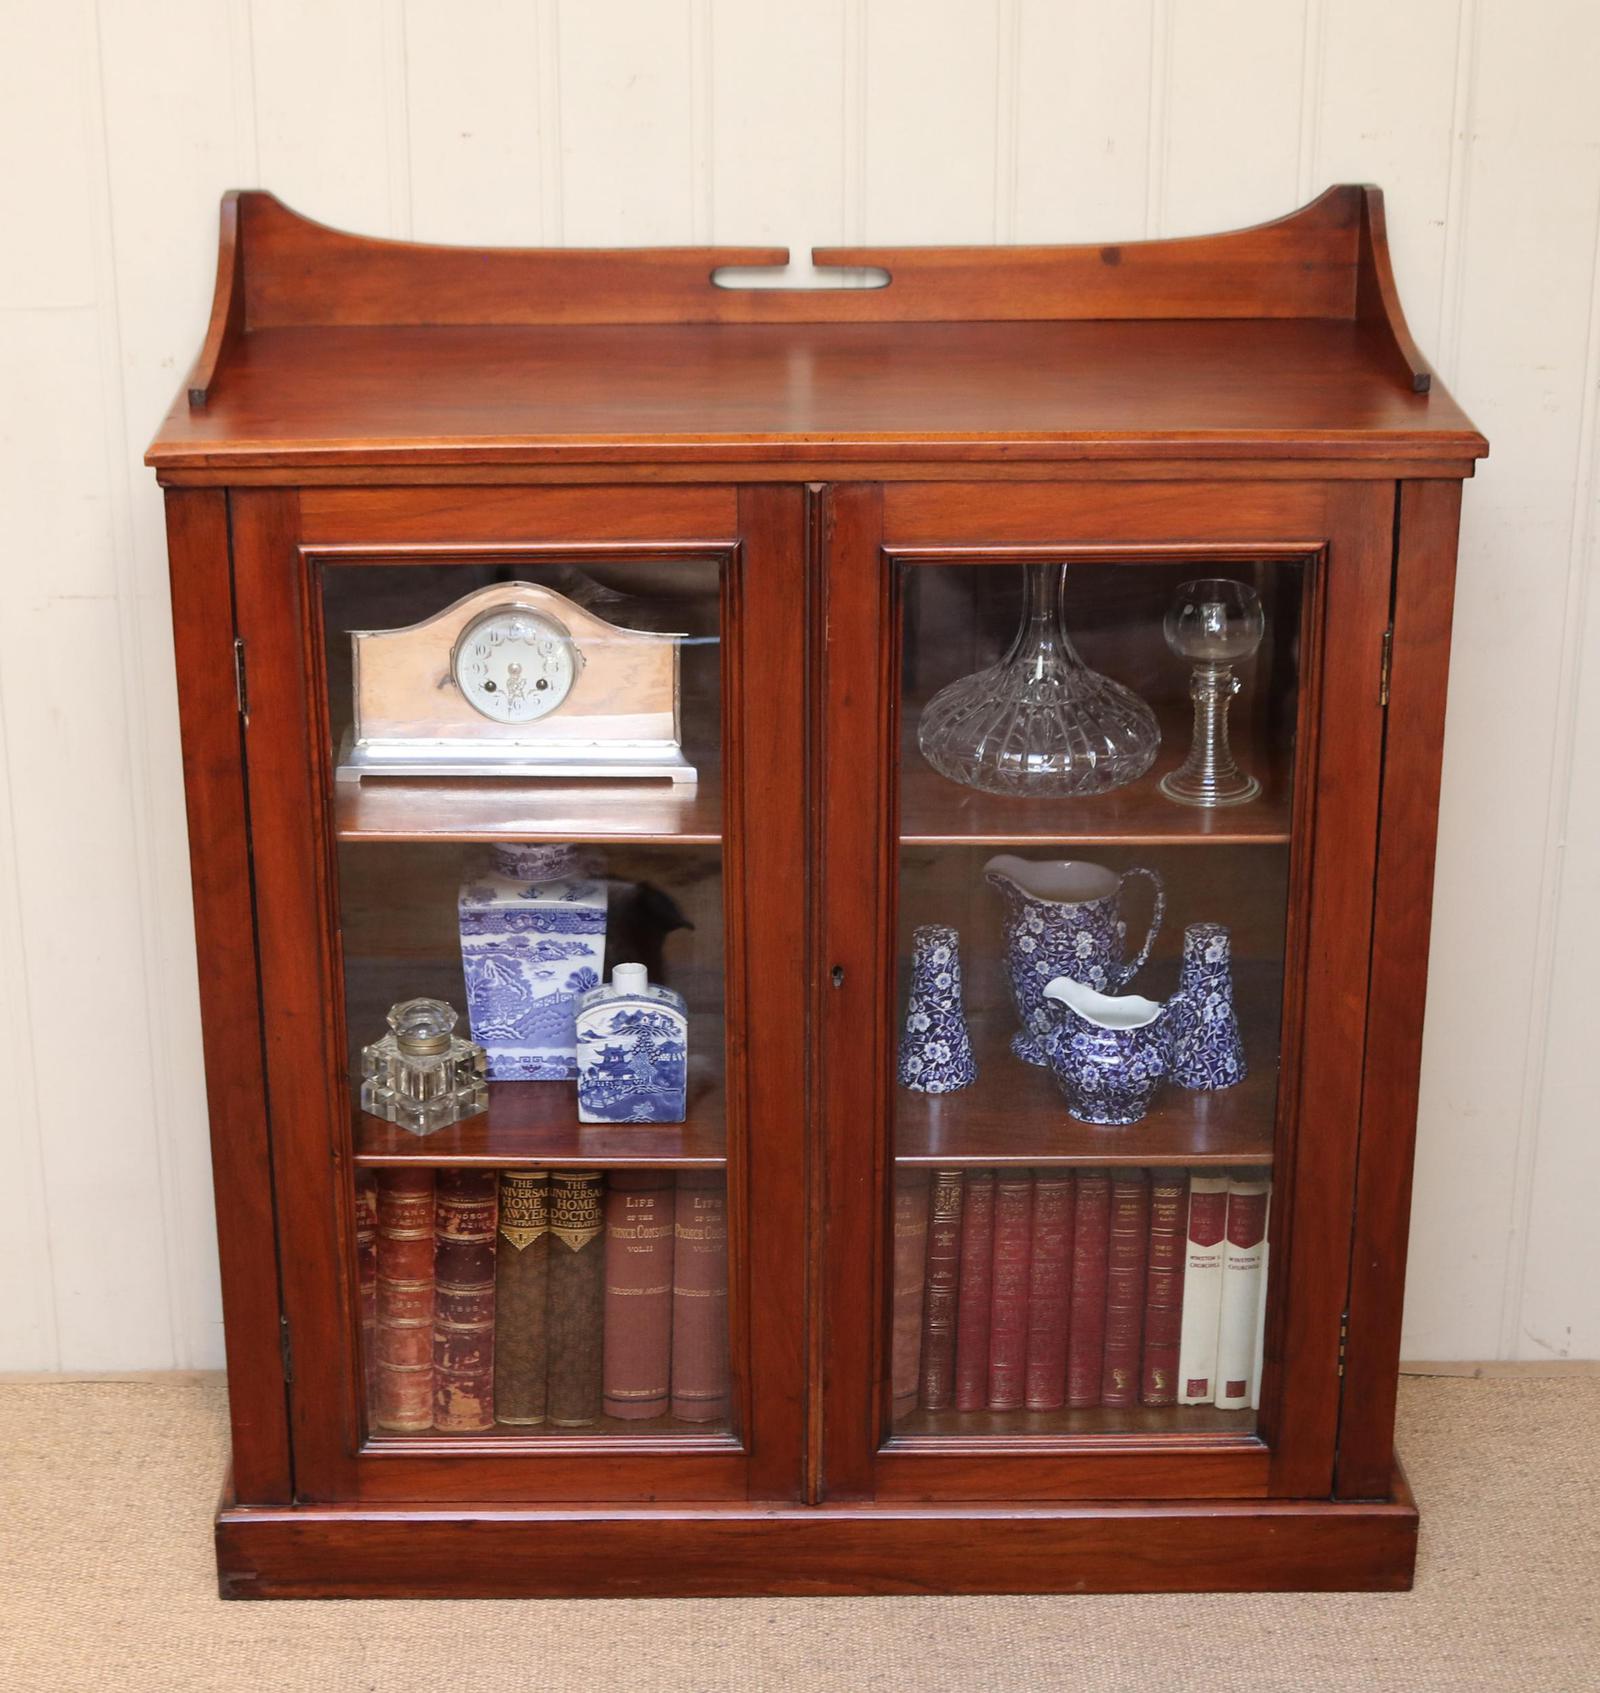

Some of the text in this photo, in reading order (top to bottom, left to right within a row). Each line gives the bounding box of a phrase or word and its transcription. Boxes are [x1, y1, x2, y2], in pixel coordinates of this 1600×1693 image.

[490, 631, 498, 641] 11
[475, 645, 486, 656] 10
[545, 642, 553, 654] 2
[472, 664, 480, 673] 9
[512, 1180, 534, 1189] THE
[566, 1181, 588, 1190] THE
[501, 1186, 549, 1199] NIVERSAL
[502, 1198, 542, 1210] HOME
[556, 1198, 598, 1211] HOME
[503, 1208, 548, 1220] AWYER
[637, 1214, 654, 1222] THE
